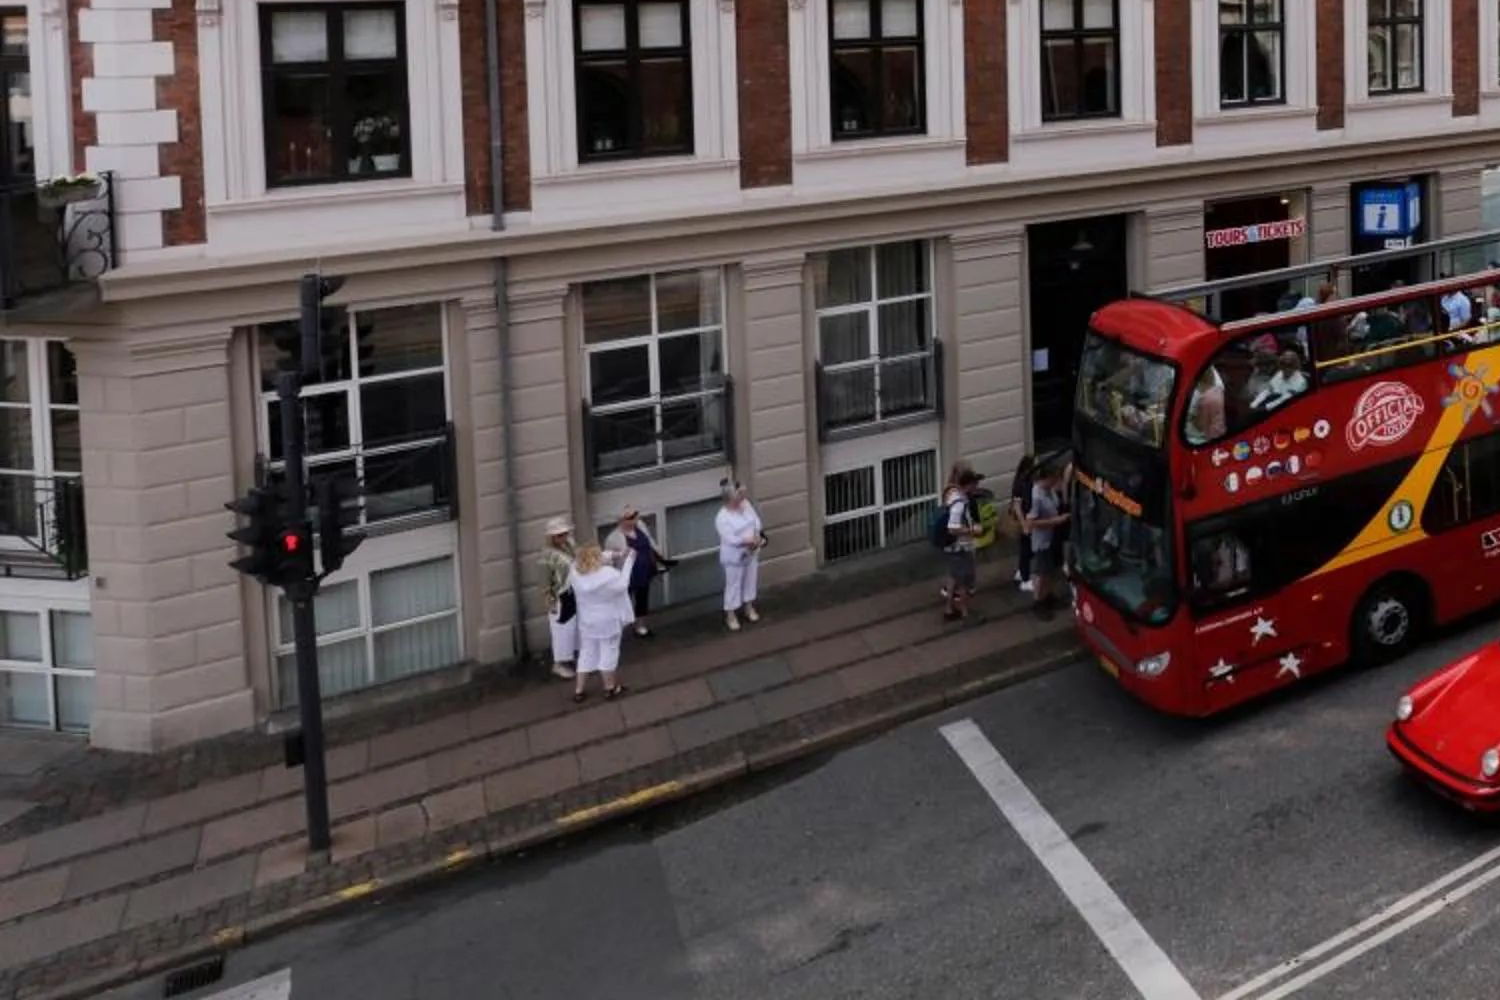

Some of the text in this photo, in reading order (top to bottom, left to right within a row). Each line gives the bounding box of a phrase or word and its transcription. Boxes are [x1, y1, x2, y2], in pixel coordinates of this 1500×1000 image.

[1206, 228, 1248, 249] TOURS
[1258, 217, 1306, 241] TICKETS
[1355, 393, 1424, 438] OFFICIAL
